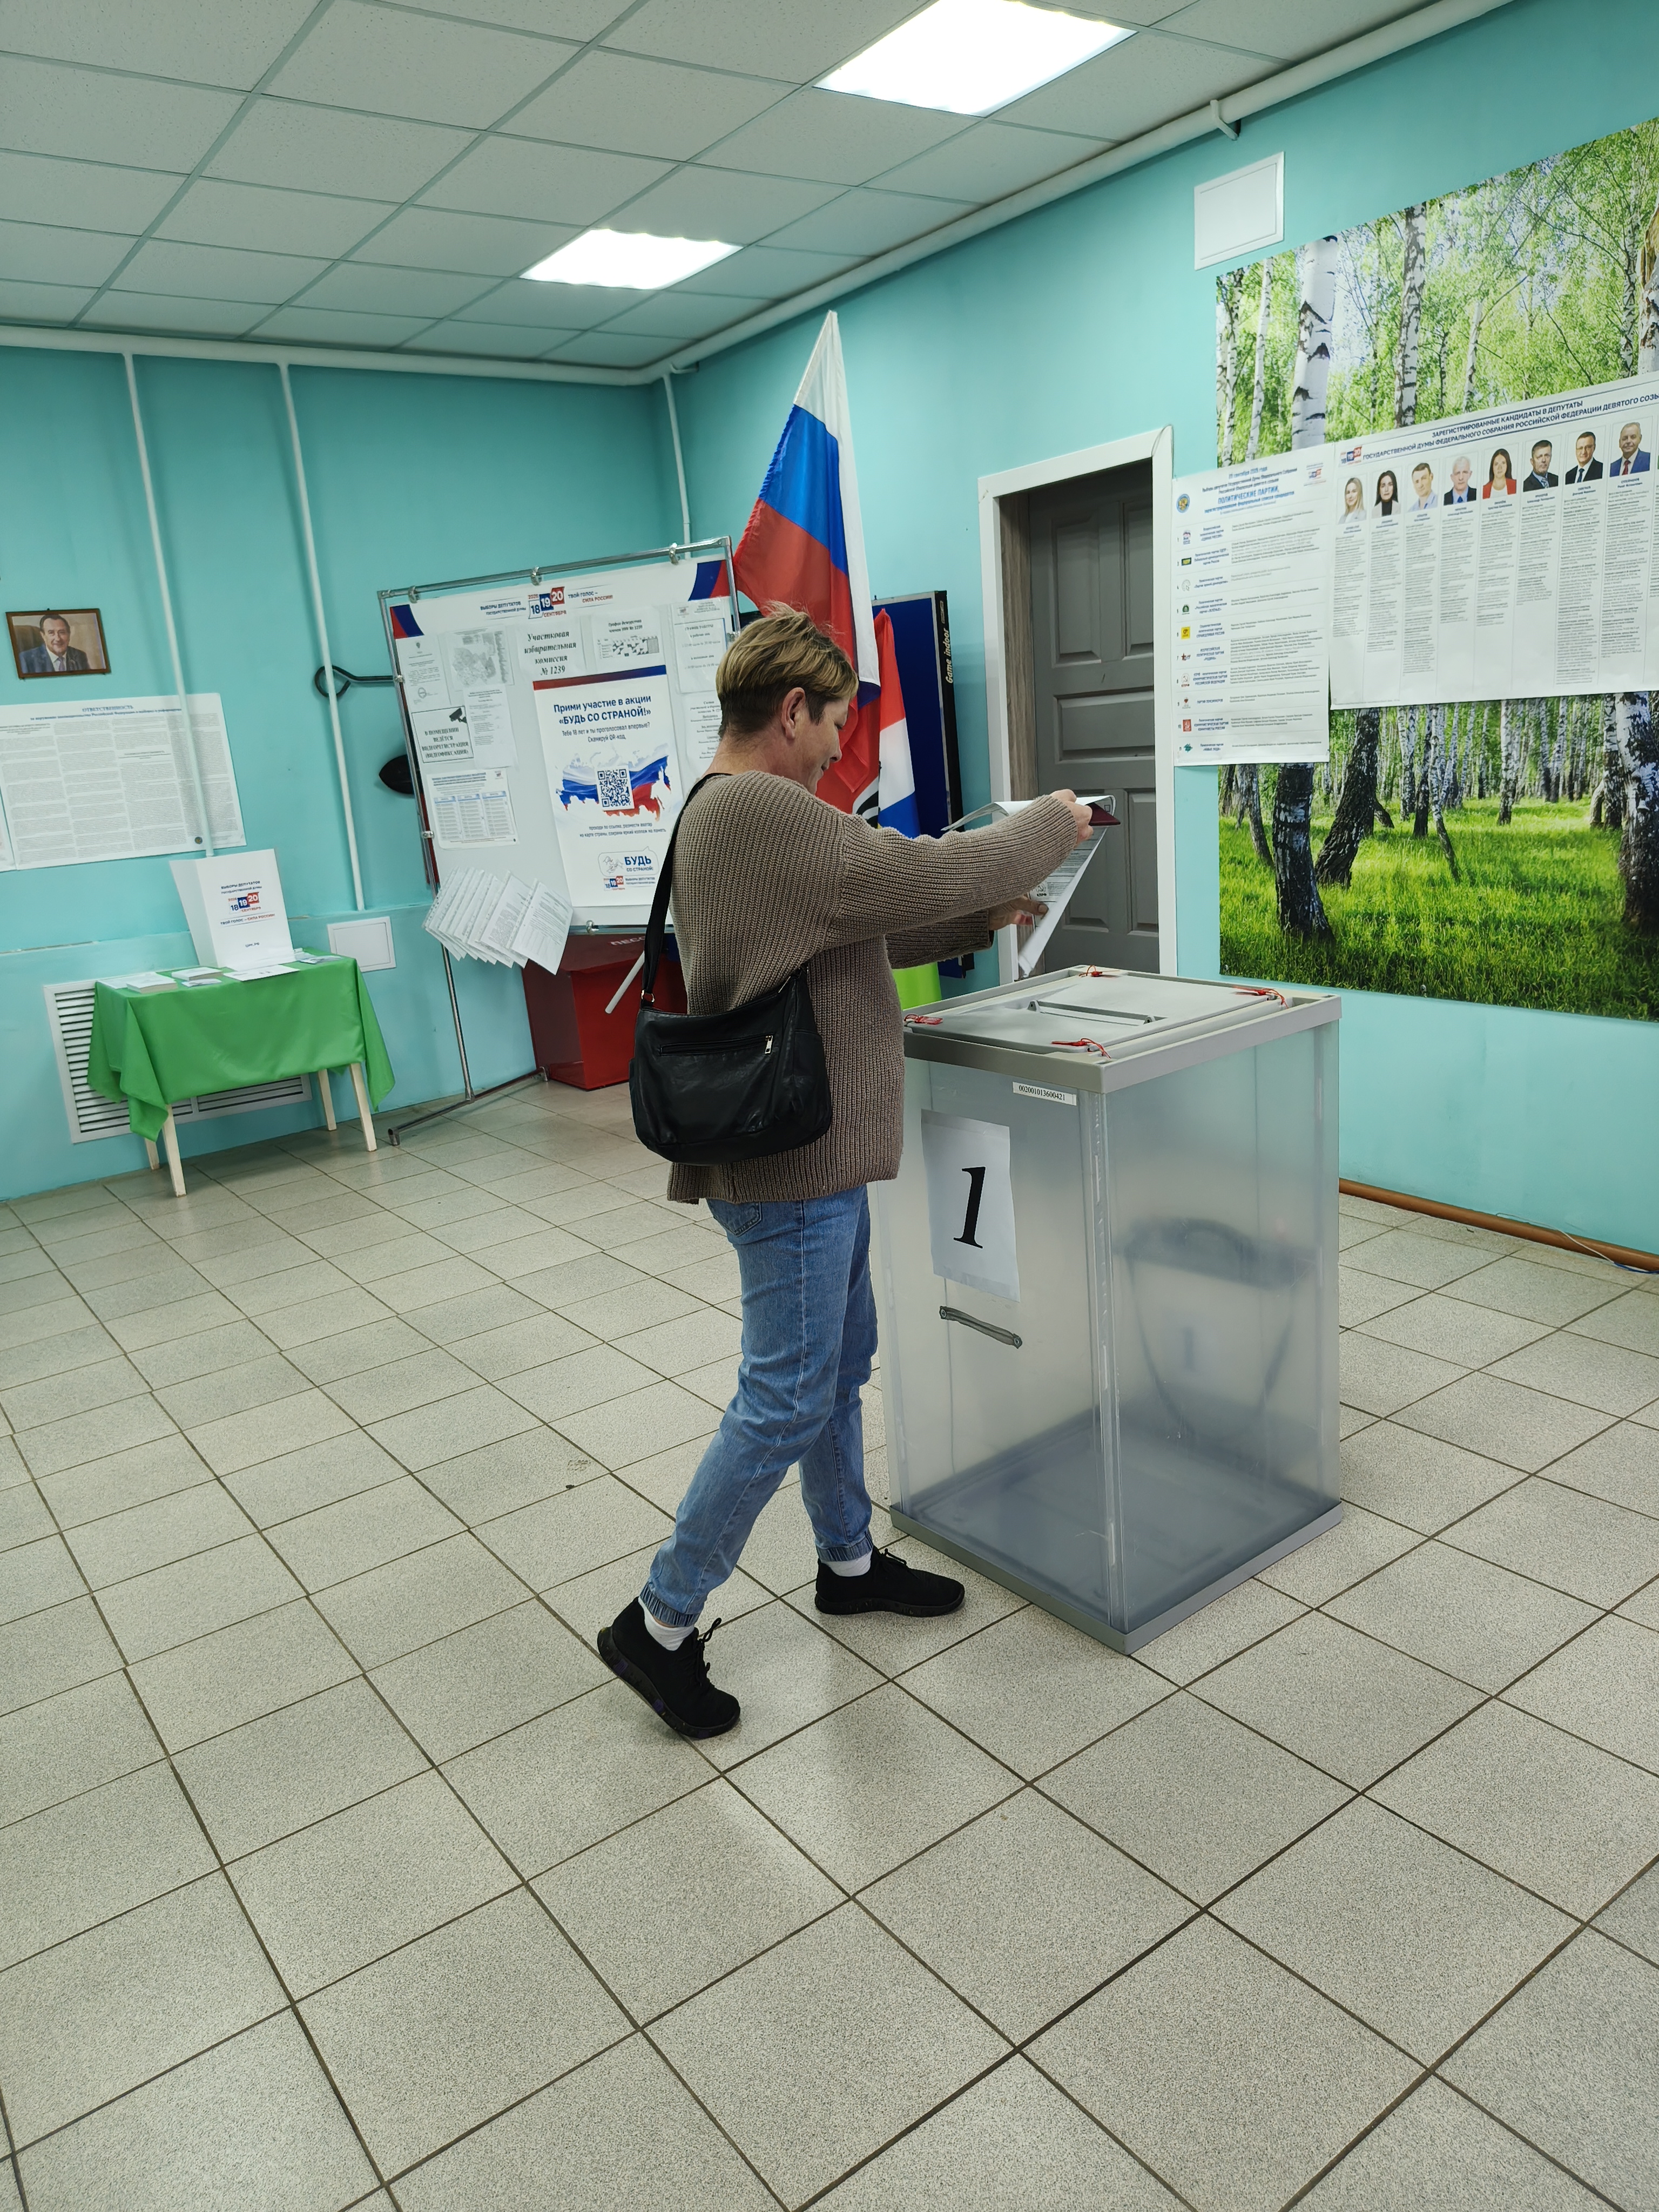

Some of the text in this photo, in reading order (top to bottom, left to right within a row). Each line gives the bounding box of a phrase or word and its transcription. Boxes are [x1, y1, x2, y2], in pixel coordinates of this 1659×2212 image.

[1432, 417, 1500, 438] ЗАРЕГИСТРИРОВАННЫЕ
[1501, 409, 1541, 422] КАНДИДАТЫ
[1548, 401, 1583, 414] ДЕПУТАТЫ
[1363, 443, 1416, 460] ГОСУДАРСТВЕННОЙ
[1417, 440, 1435, 449] ДУМЫ
[1435, 430, 1481, 446] ФЕДЕРАЛЬНОГО
[1482, 423, 1514, 436] СОБРАНИЯ
[1515, 413, 1560, 428] РОССИЙСКОЙ
[1561, 405, 1602, 420] ФЕДЕРАЦИИ
[1602, 397, 1638, 411] ДЕВЯТОГО
[1218, 490, 1256, 504] ПОЛИТИЧЕСКИЕ
[551, 590, 563, 602] 20
[531, 597, 551, 615] 18 19
[528, 631, 570, 642] Участковая
[943, 628, 951, 656] indoor
[524, 642, 577, 654] избирательная
[535, 656, 568, 664] комиссия
[541, 665, 565, 676] № 1239
[554, 704, 581, 714] Прими
[583, 700, 616, 711] участие
[625, 695, 651, 705] акции
[559, 706, 651, 725] «БУДЬ СО СТРАНОЙ!»
[596, 725, 628, 733] проголосовал
[624, 855, 651, 866] БУДЬ
[248, 894, 258, 902] 20
[1019, 1084, 1065, 1101] 002001013600421
[953, 1166, 986, 1249] 1
